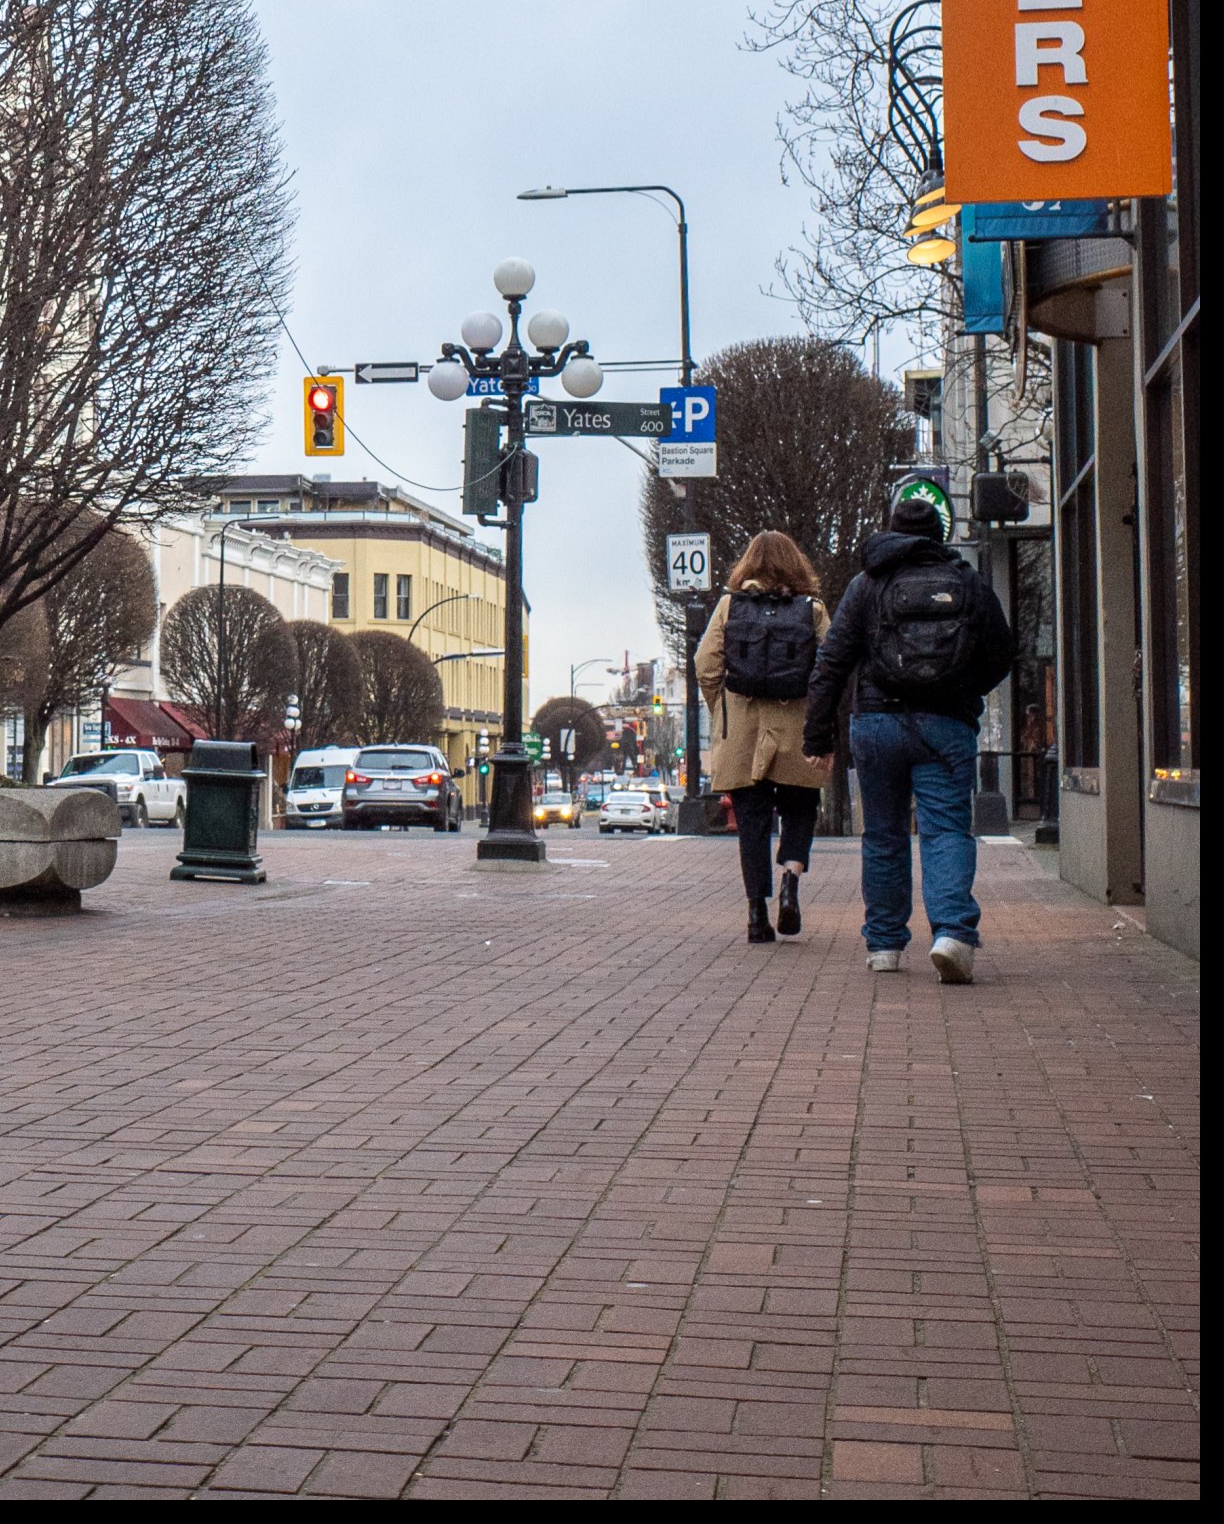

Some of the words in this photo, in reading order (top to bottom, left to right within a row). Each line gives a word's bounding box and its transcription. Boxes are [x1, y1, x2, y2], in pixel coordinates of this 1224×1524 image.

[468, 377, 504, 394] Yat
[563, 408, 611, 428] Yates
[640, 407, 660, 416] Street
[684, 396, 710, 433] P
[640, 421, 664, 432] 600
[661, 447, 688, 455] Bastion
[689, 446, 714, 456] Square
[661, 457, 695, 465] Parkade
[672, 550, 706, 575] 40
